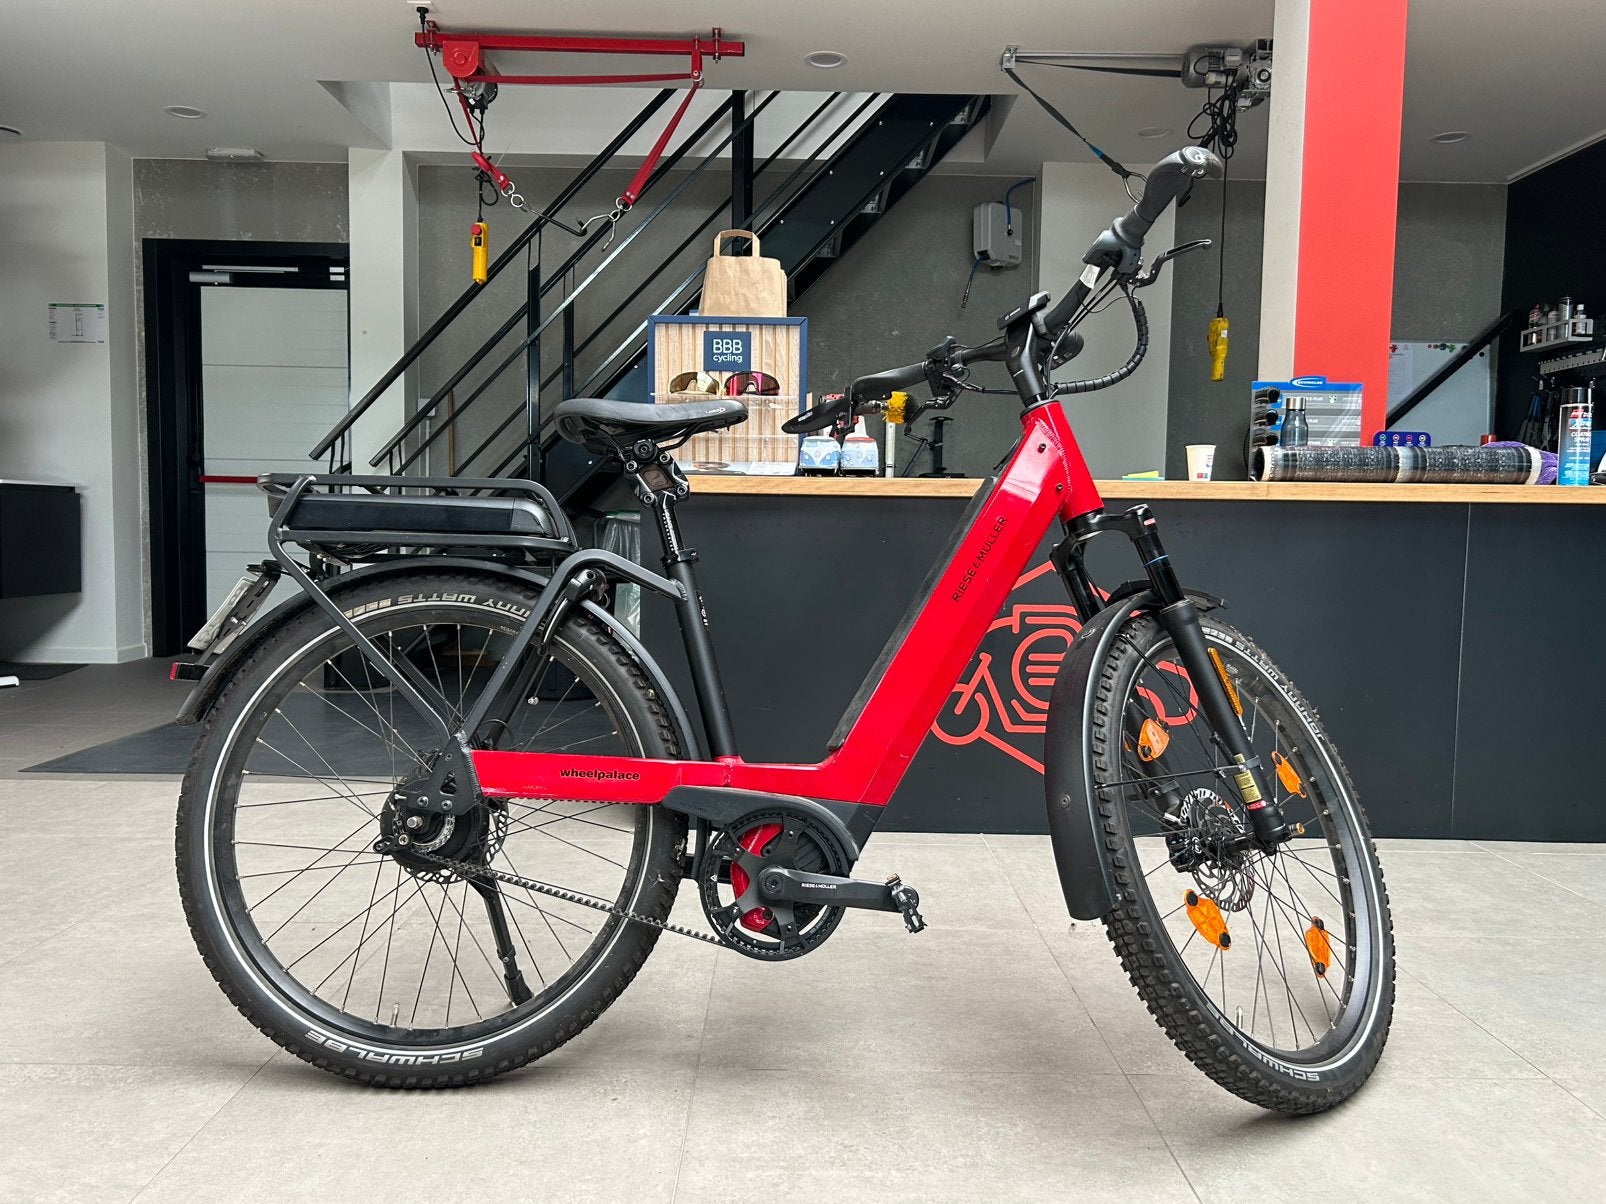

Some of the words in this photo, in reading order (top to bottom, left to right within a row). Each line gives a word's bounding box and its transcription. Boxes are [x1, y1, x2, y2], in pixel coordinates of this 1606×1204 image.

[713, 339, 742, 353] BBB
[713, 354, 743, 363] cycling
[397, 593, 476, 605] WATTS
[951, 568, 976, 602] RIESE
[1234, 641, 1279, 680] WATTS
[1280, 684, 1325, 740] JOHNNY
[560, 768, 640, 781] wheelpalace
[304, 1029, 484, 1065] SCHWALBE
[1206, 1002, 1320, 1081] SCHWALBE
